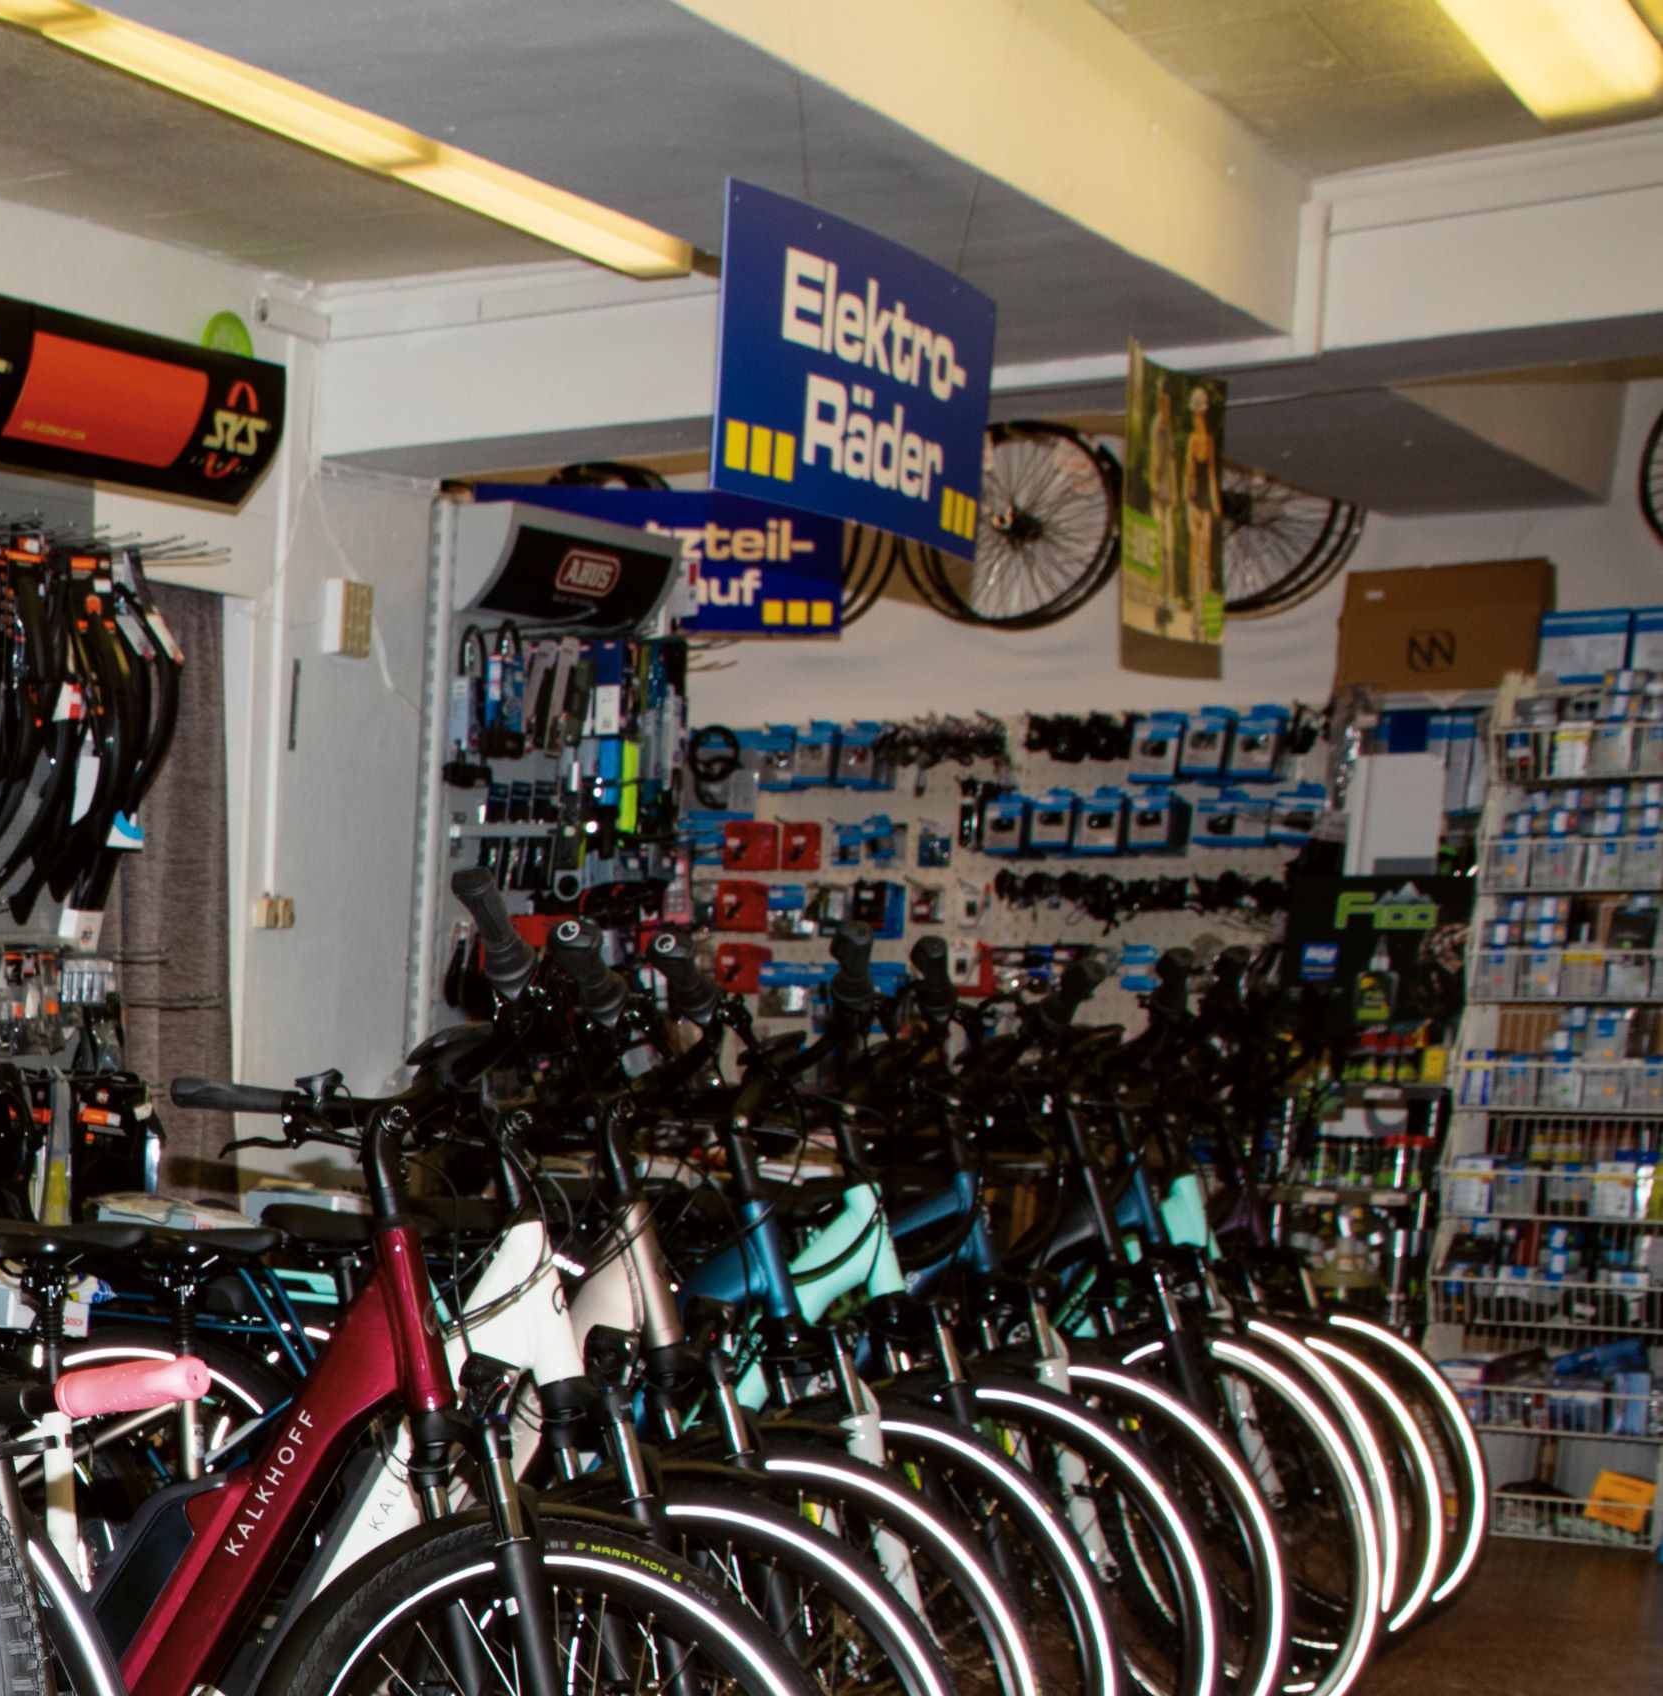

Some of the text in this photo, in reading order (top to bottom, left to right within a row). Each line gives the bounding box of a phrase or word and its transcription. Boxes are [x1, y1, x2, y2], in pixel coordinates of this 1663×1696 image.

[782, 247, 968, 402] Elektro-
[202, 407, 268, 457] SKS
[800, 374, 944, 502] Räder
[563, 556, 613, 590] ABUS
[224, 1409, 316, 1557] KALKHOFF
[589, 1542, 669, 1578] MARATHON
[684, 1579, 719, 1607] PLUS
